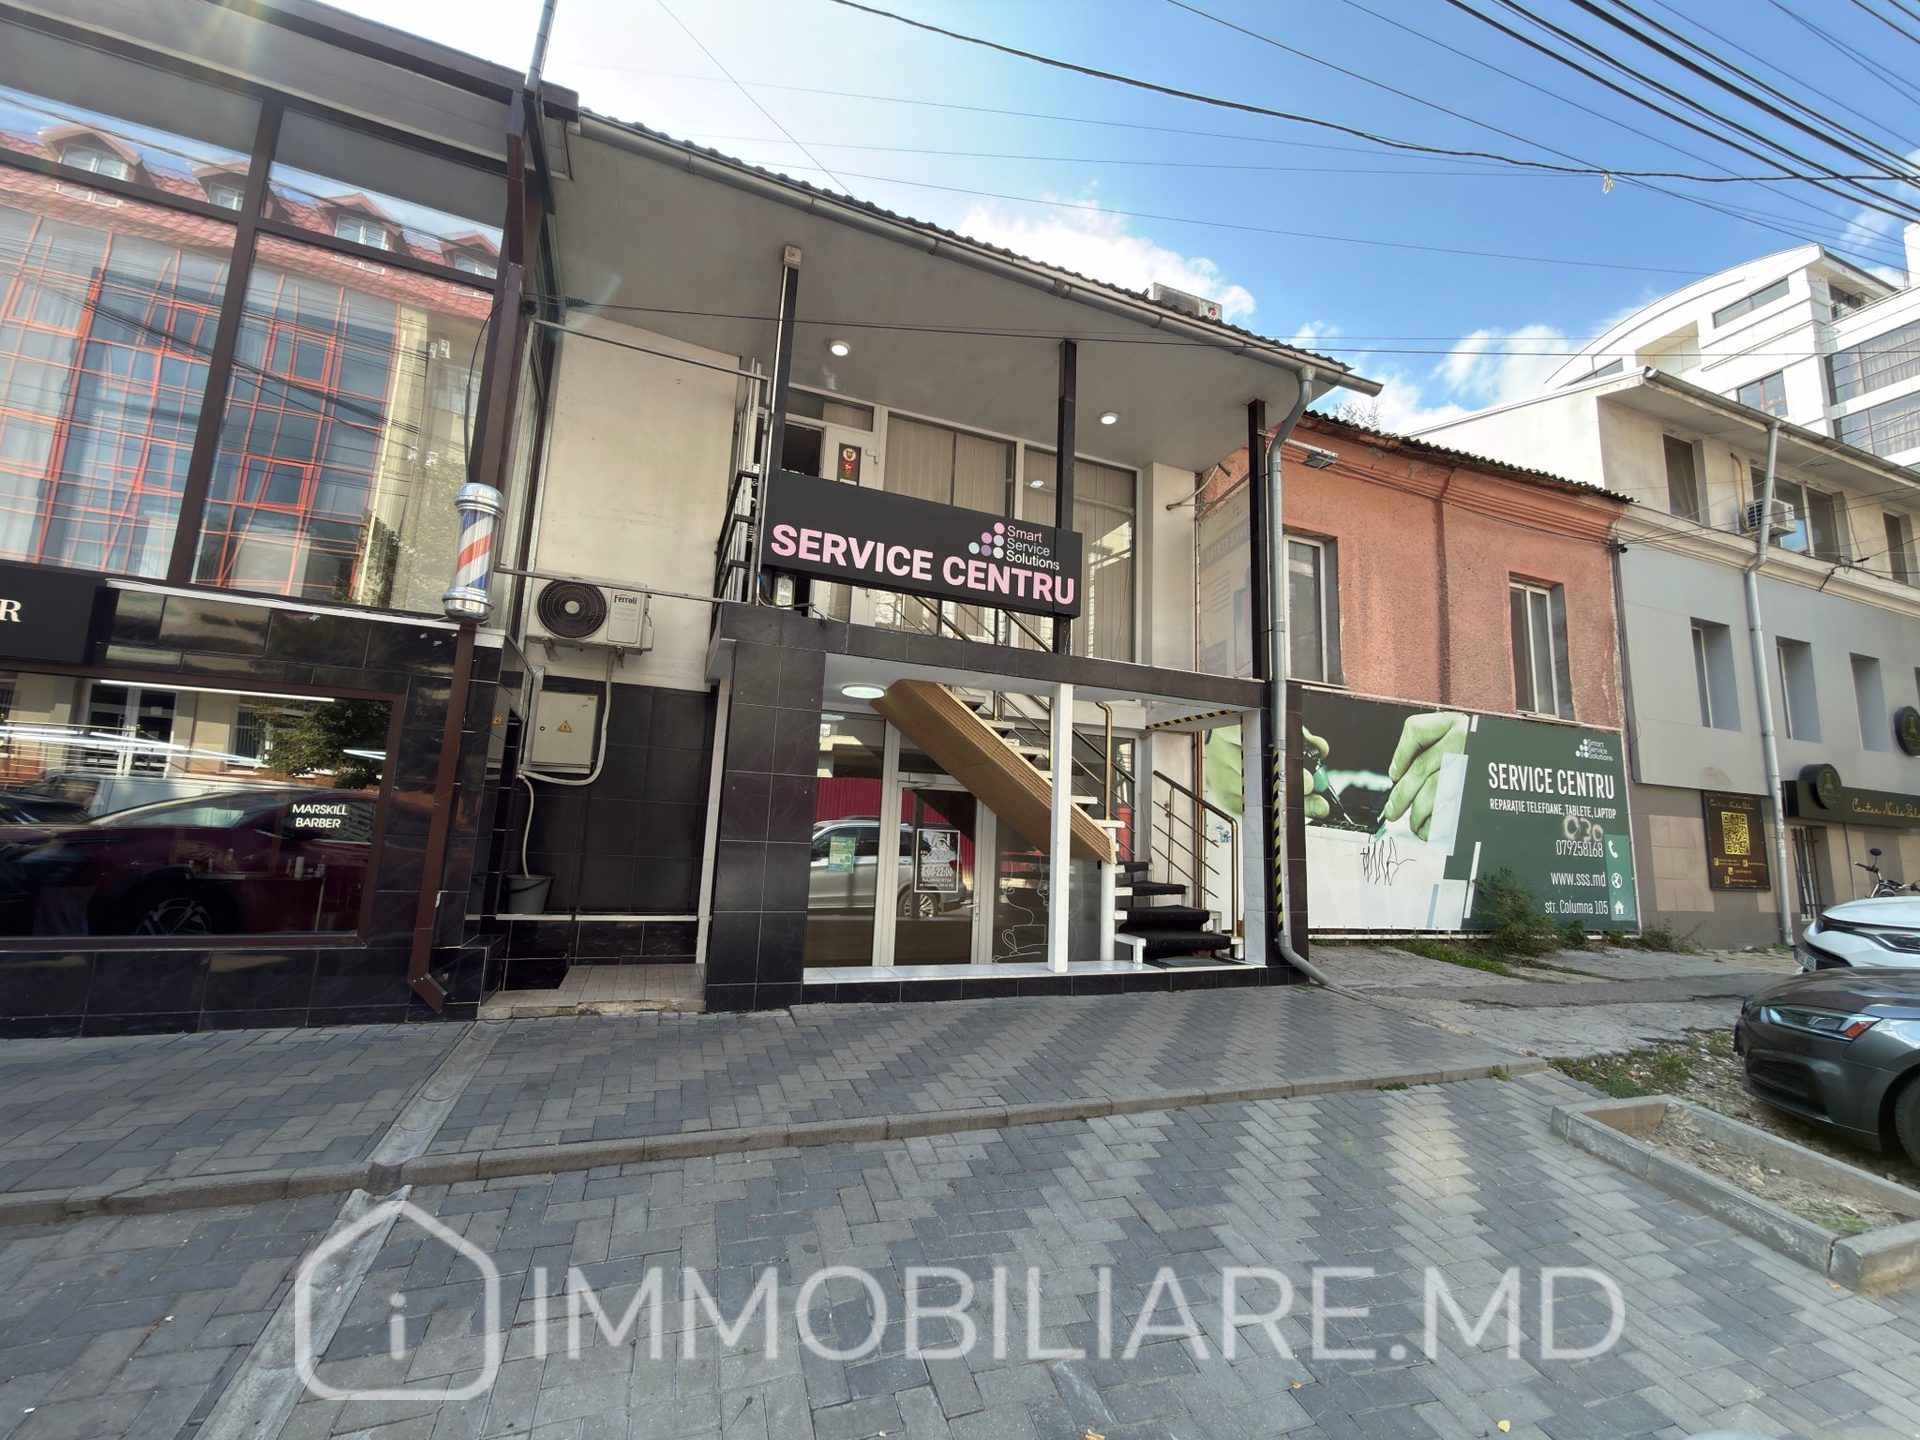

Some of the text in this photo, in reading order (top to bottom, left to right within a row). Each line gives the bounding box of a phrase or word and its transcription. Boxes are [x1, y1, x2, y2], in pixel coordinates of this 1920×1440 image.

[1007, 525, 1043, 543] Smart
[1006, 538, 1050, 557] Service
[771, 524, 1075, 605] SERVICE CENTRU
[1006, 550, 1060, 571] Solutions
[614, 594, 638, 604] Ferroli
[1587, 739, 1604, 748] Smart
[1587, 746, 1608, 754] Service
[1588, 752, 1614, 761] Solutions
[1488, 762, 1615, 799] SERVICE CENTRU
[292, 804, 348, 815] MARSKILL
[1526, 801, 1565, 816] TELEFOANE,
[1565, 804, 1594, 819] TABLETE,
[1594, 807, 1617, 819] LAPTOP
[295, 817, 342, 828] BARBER
[1556, 840, 1604, 857] 079258168
[1550, 872, 1606, 887] www.sss.md
[1545, 900, 1609, 914] str. Columna 105
